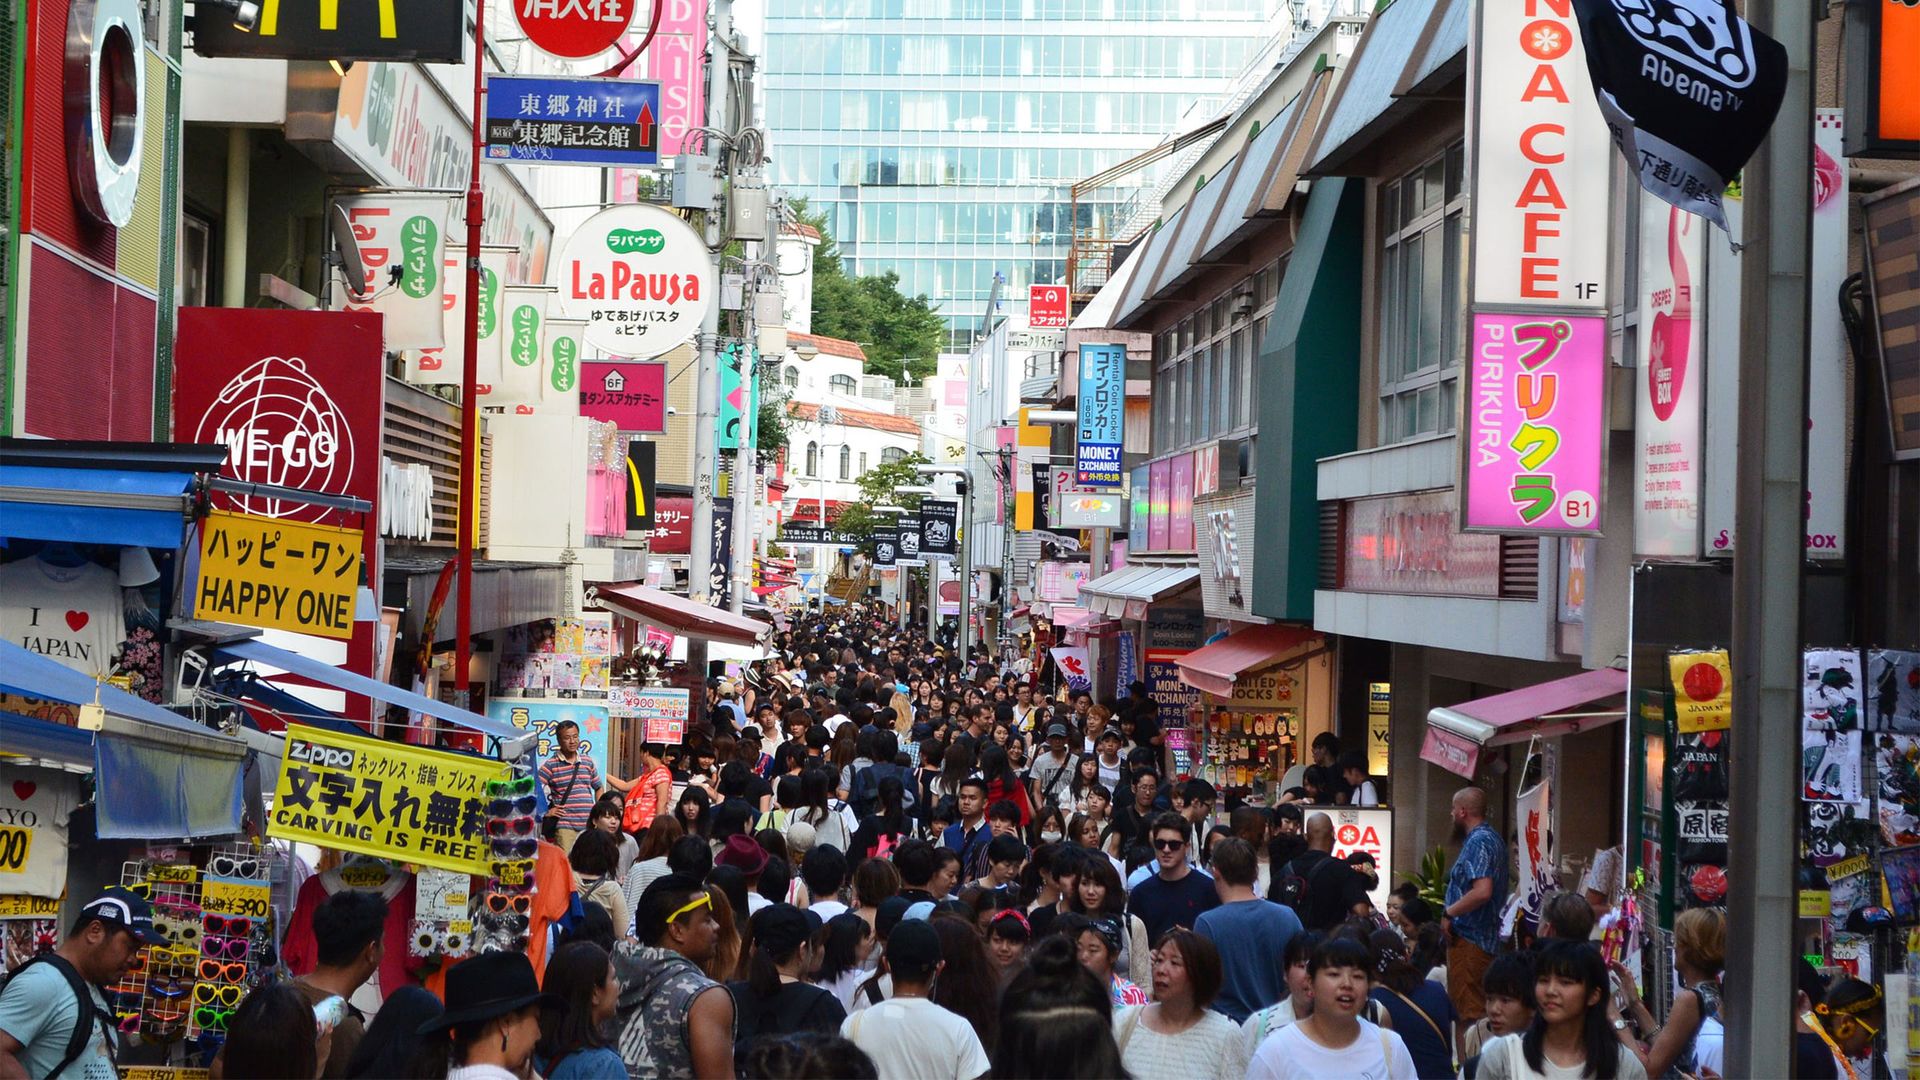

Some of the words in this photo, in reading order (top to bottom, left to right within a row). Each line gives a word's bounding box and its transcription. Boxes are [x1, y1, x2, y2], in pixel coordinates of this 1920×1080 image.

[1641, 53, 1723, 112] Abema
[518, 93, 625, 119] 東郷神社
[517, 123, 631, 148] 東郷記念館
[1514, 122, 1568, 299] CAFE
[608, 235, 663, 247] ラパウザ
[572, 260, 605, 300] La
[612, 260, 699, 305] Pausa
[1574, 284, 1599, 300] 1F
[1038, 316, 1066, 326] アガサ
[607, 379, 621, 388] 6F
[1095, 351, 1110, 440] コインロッカー
[1477, 323, 1505, 468] PURIKURA
[1509, 320, 1572, 524] プリクラ
[1079, 446, 1121, 460] MONEY
[1079, 461, 1121, 472] EXCHANGE
[1566, 501, 1591, 518] B1
[207, 528, 355, 579] ハッピーワン
[200, 576, 291, 617] HAPPY
[296, 588, 351, 629] ONE
[29, 607, 41, 627] I
[23, 636, 91, 661] JAPAN
[1681, 752, 1718, 762] JAPAN
[275, 809, 373, 842] CARVING
[384, 830, 409, 848] IS
[1333, 824, 1381, 846] OA
[1683, 813, 1729, 834] 原宿
